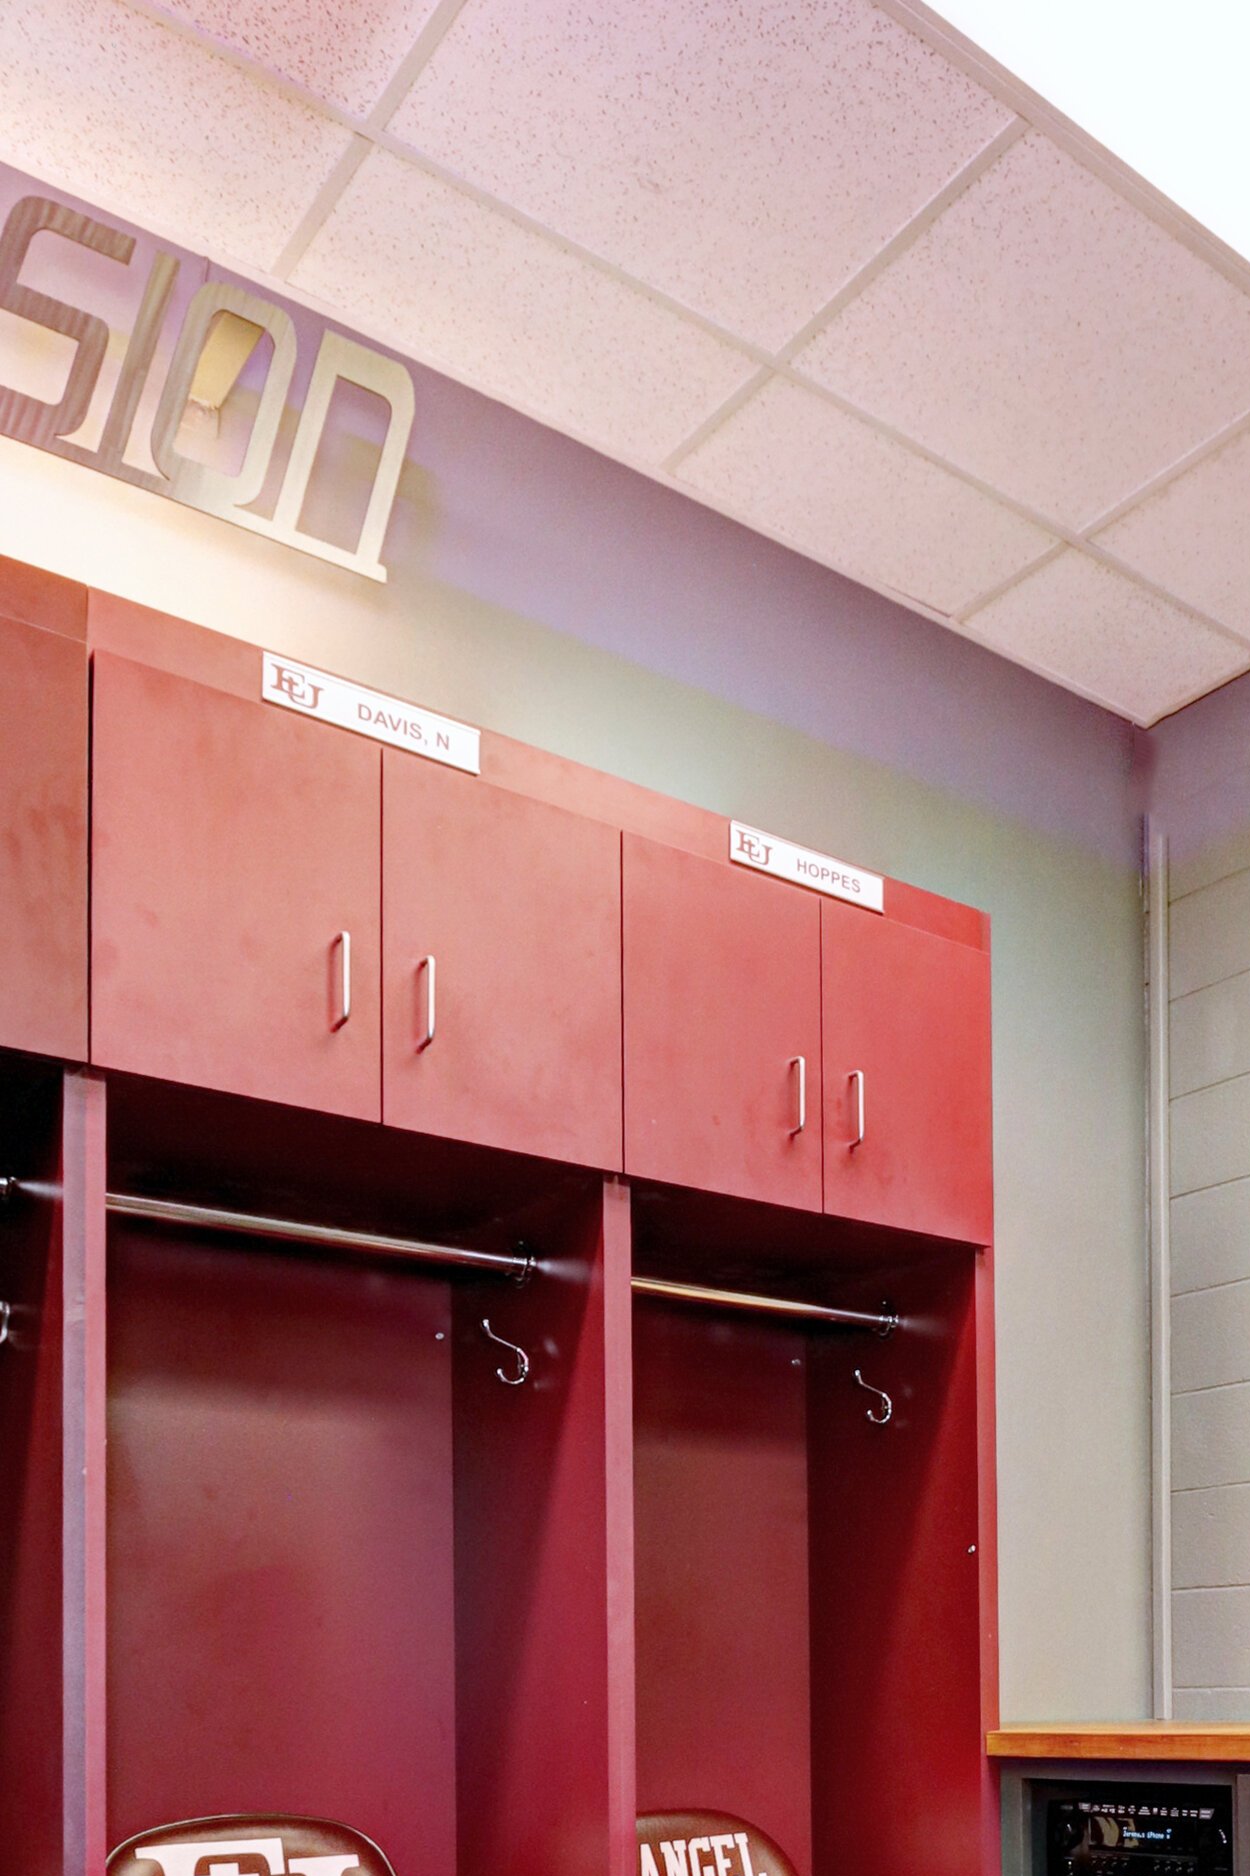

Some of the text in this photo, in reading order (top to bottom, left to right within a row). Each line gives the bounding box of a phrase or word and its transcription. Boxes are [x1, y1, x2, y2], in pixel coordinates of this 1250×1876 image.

[357, 702, 449, 751] DAVIS, N
[796, 858, 861, 894] HOPPES
